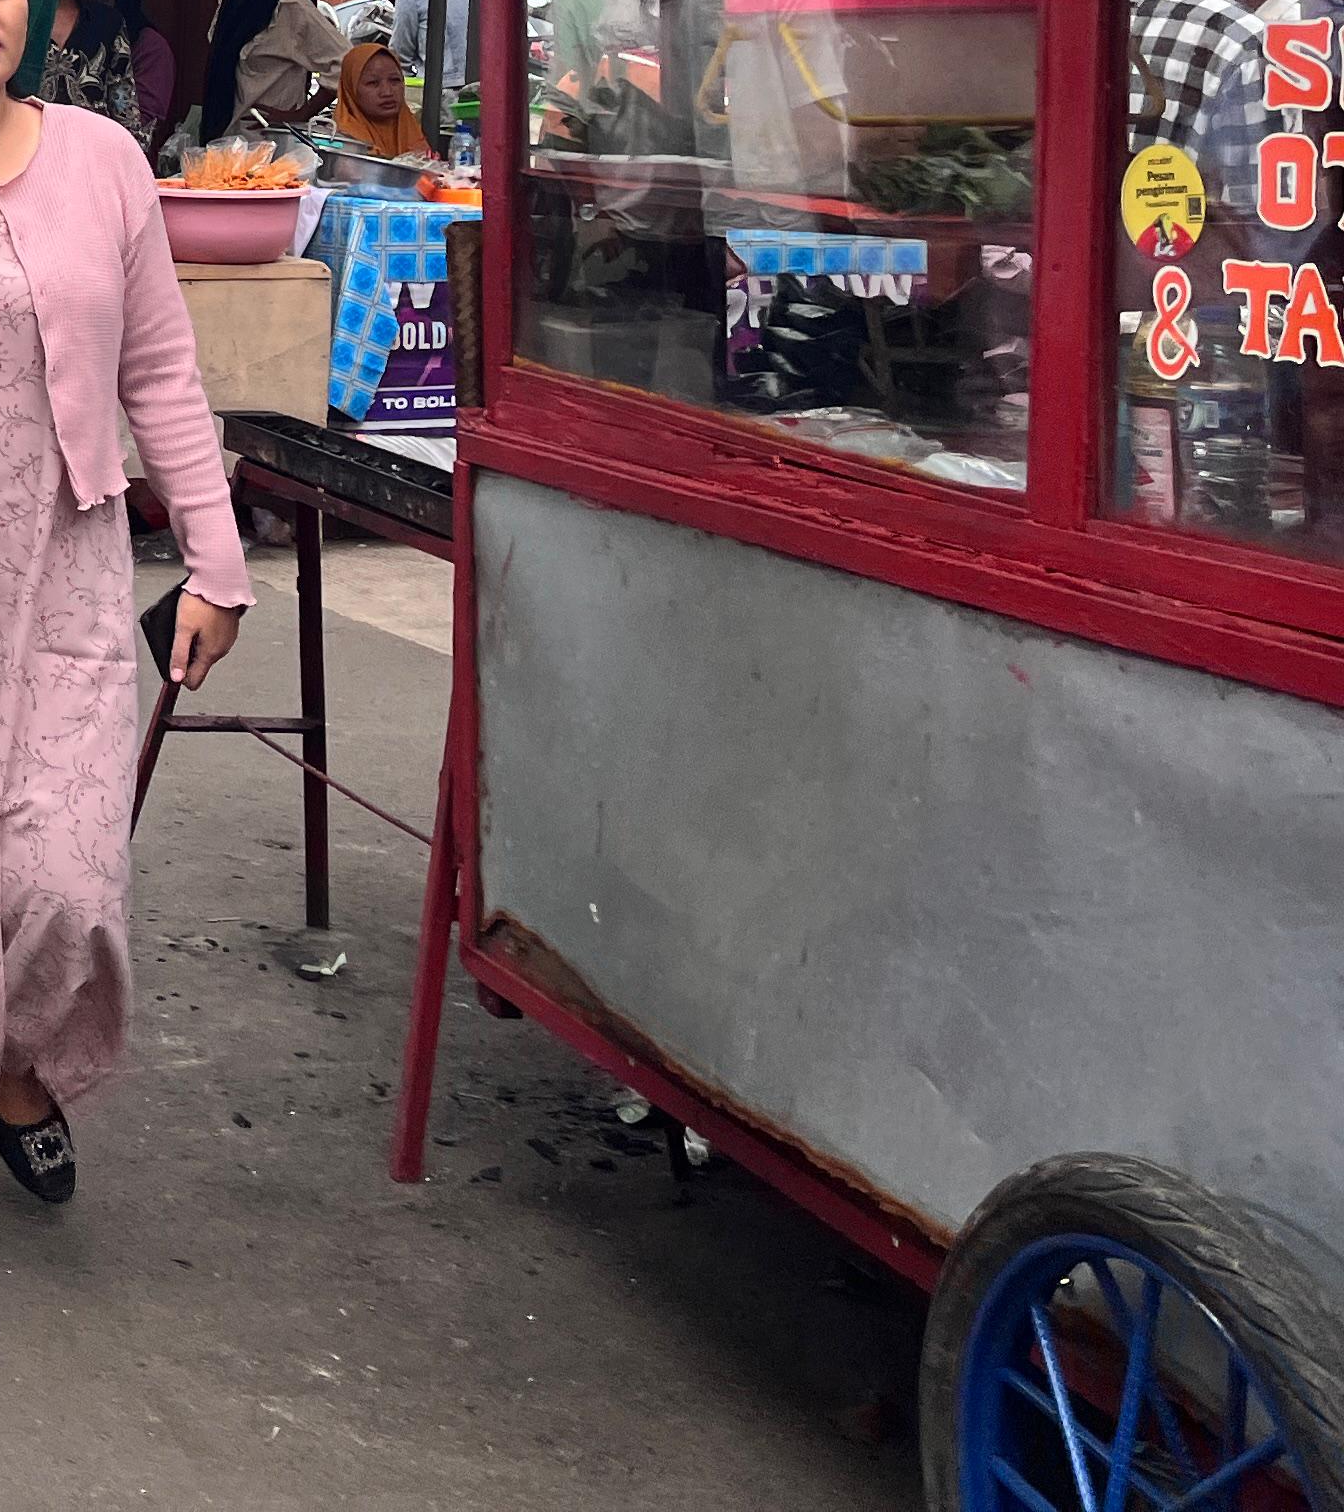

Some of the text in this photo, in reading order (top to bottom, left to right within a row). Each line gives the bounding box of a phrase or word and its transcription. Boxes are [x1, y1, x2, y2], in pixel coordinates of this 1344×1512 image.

[1263, 16, 1344, 112] S
[392, 320, 447, 351] OLD
[383, 396, 409, 410] TO
